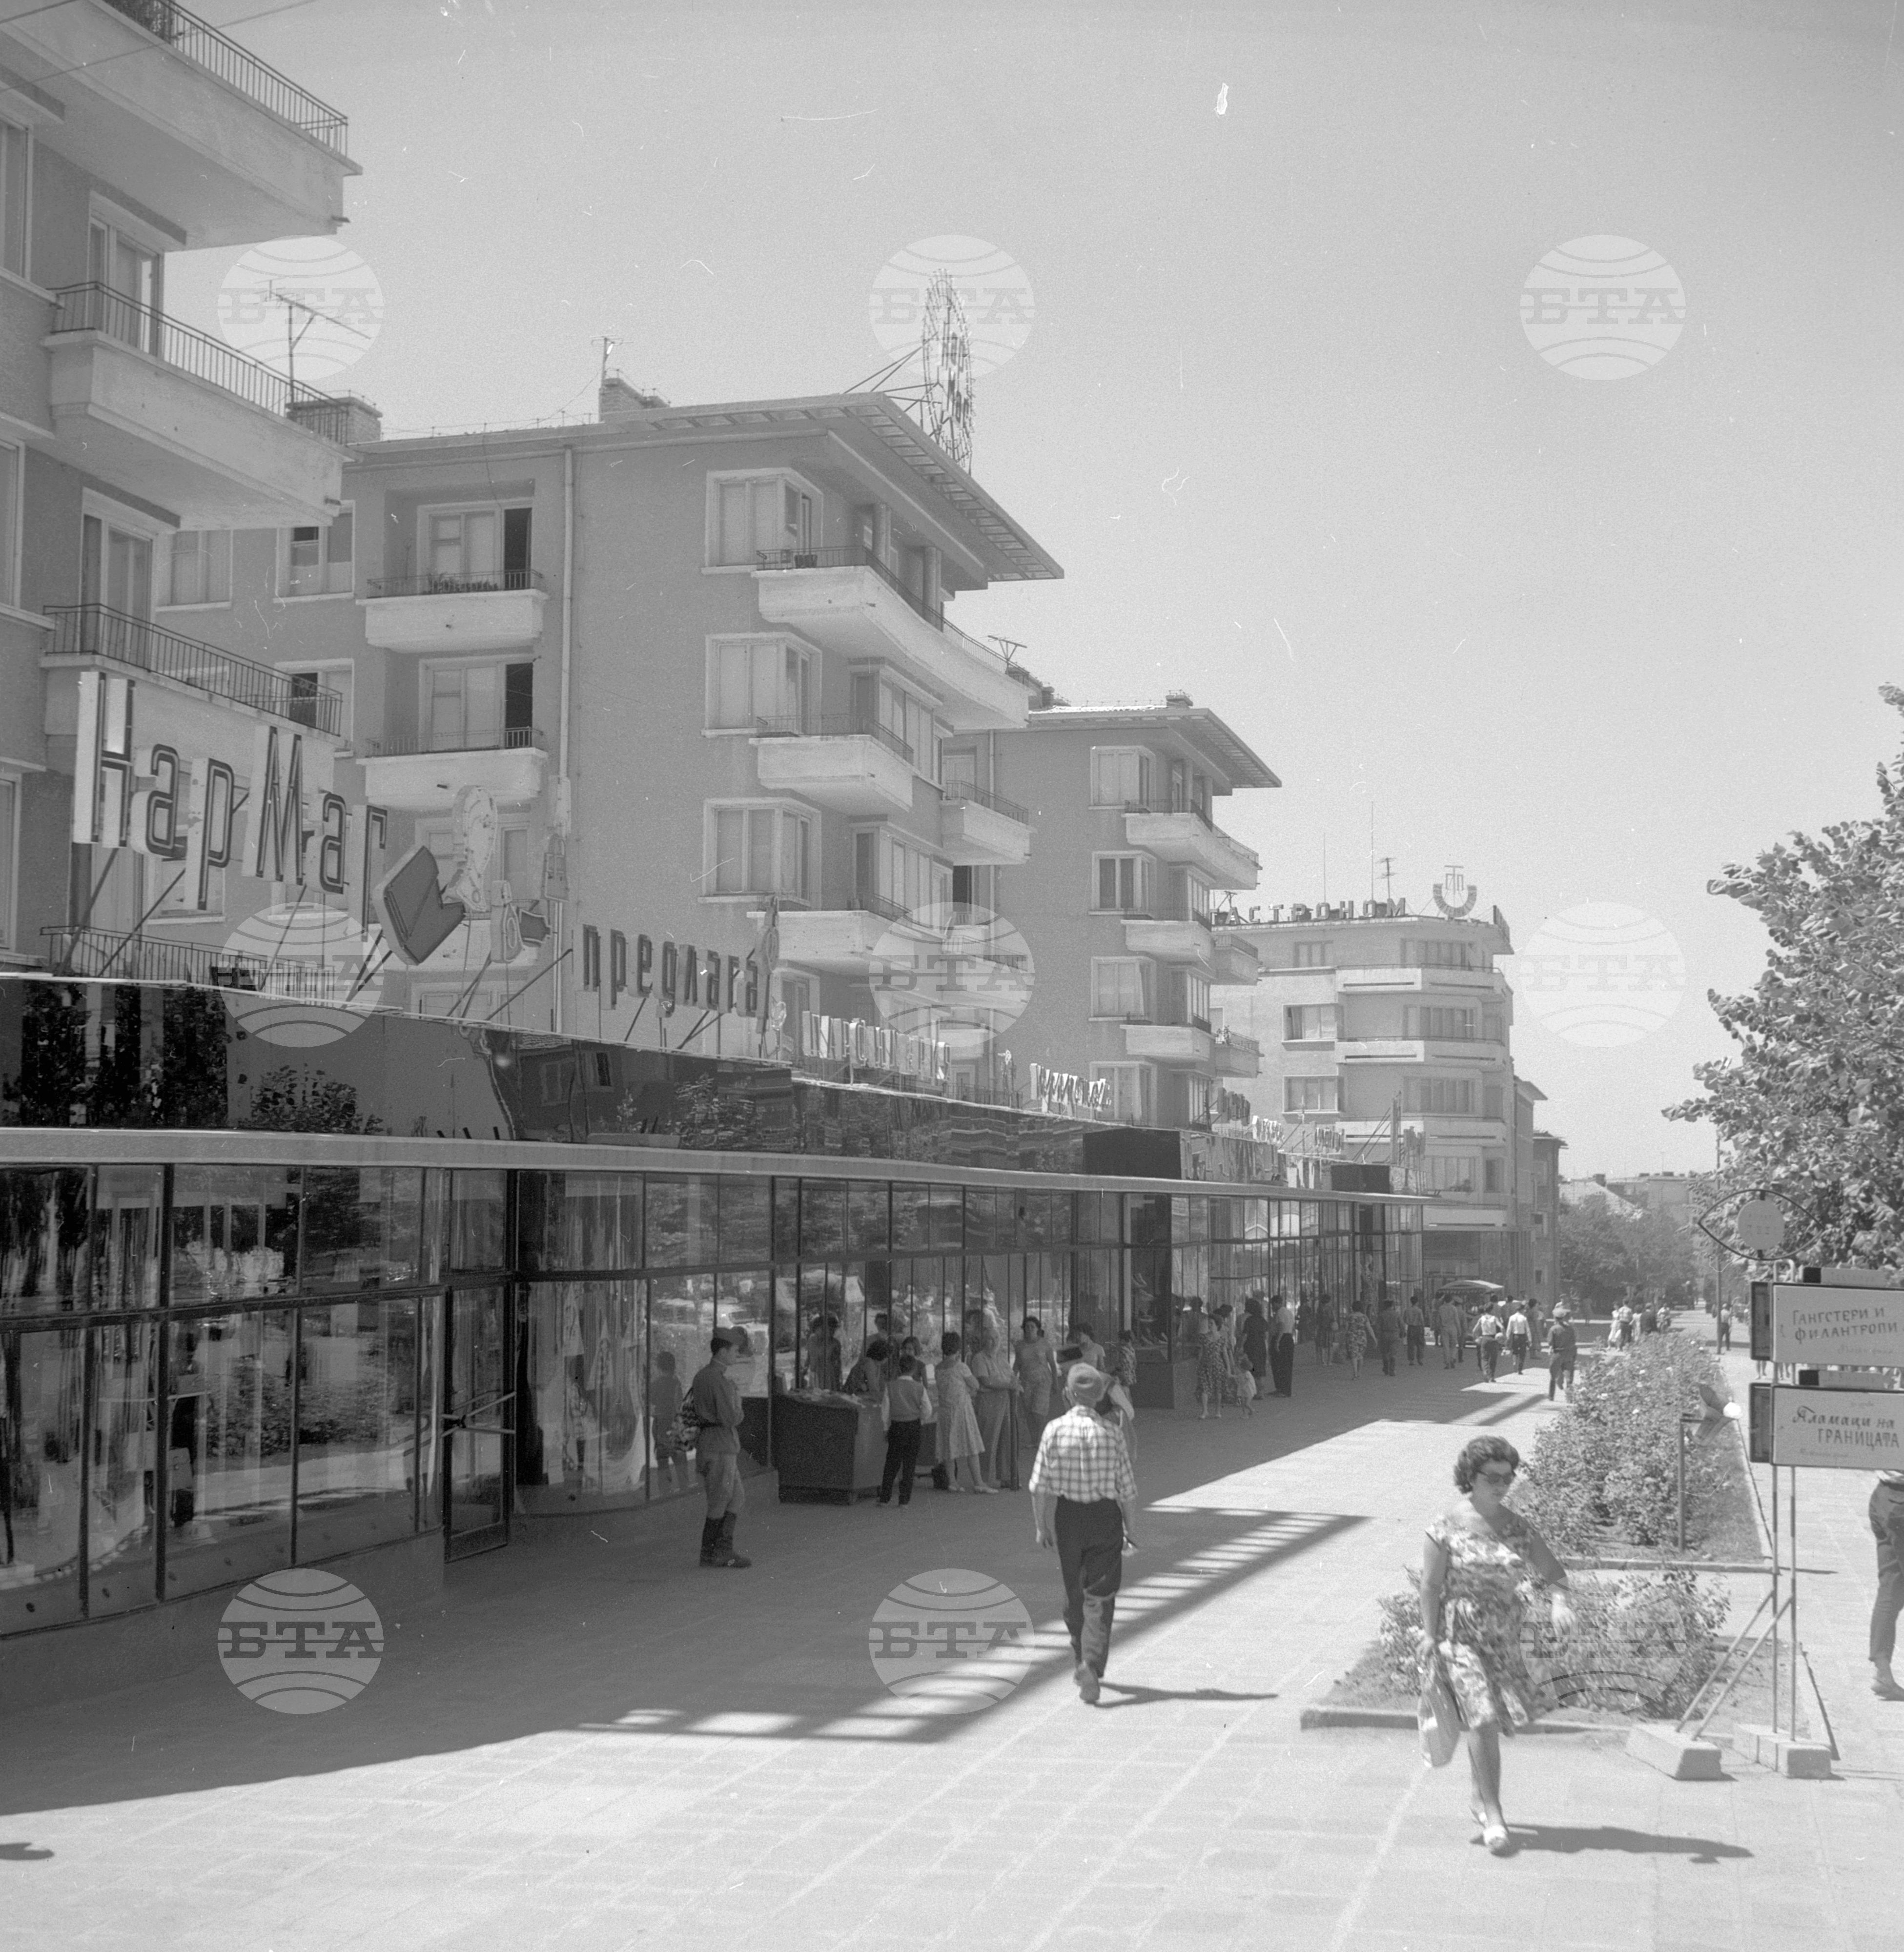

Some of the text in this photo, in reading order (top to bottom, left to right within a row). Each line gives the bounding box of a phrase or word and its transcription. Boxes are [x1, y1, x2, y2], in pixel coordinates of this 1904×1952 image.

[73, 671, 388, 942] НарМаг
[1209, 897, 1407, 925] ГАСТРОНОМ
[573, 924, 758, 1019] предлага
[1875, 1307, 1884, 1317] И
[1876, 1418, 1895, 1429] на
[1818, 1428, 1900, 1451] ГРАНИЦАТА
